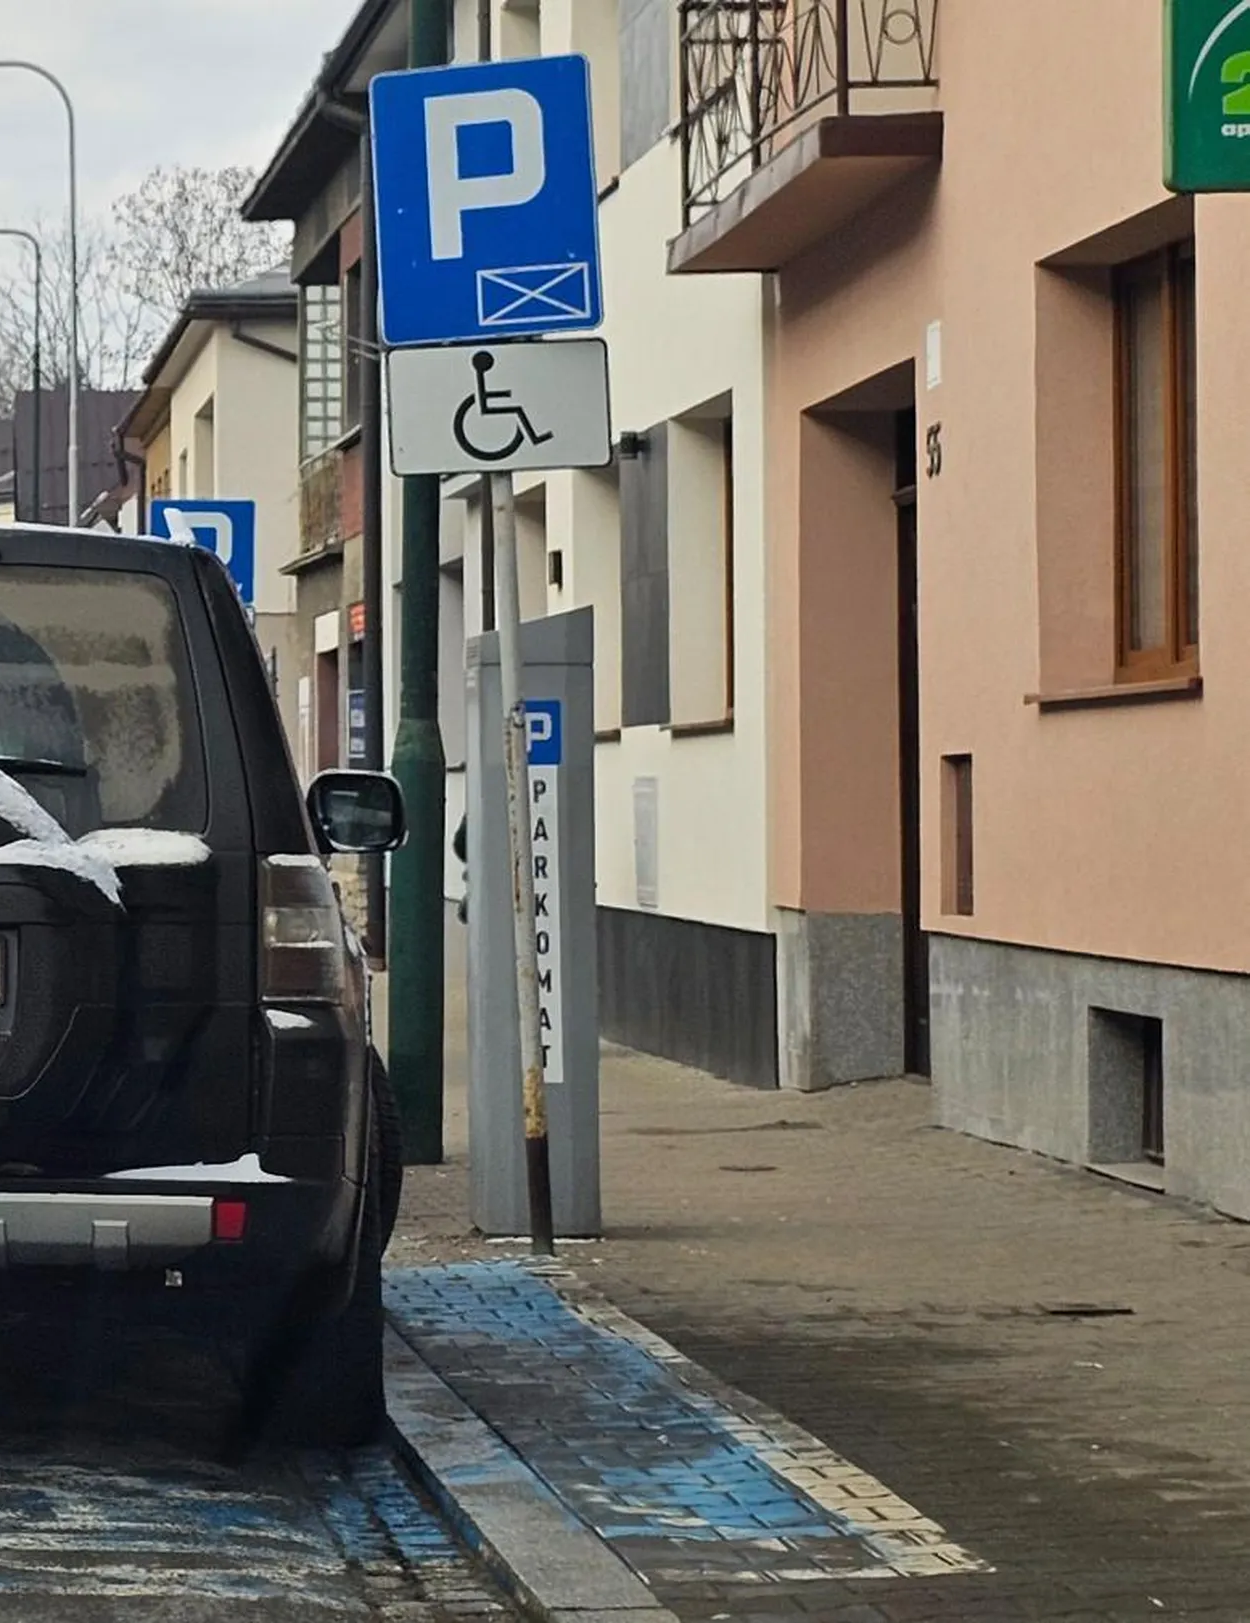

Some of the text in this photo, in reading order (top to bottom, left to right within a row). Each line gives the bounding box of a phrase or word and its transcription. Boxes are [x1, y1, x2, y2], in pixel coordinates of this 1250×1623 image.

[424, 88, 546, 260] P
[525, 712, 552, 753] P
[533, 779, 552, 1069] PARKOMAT
